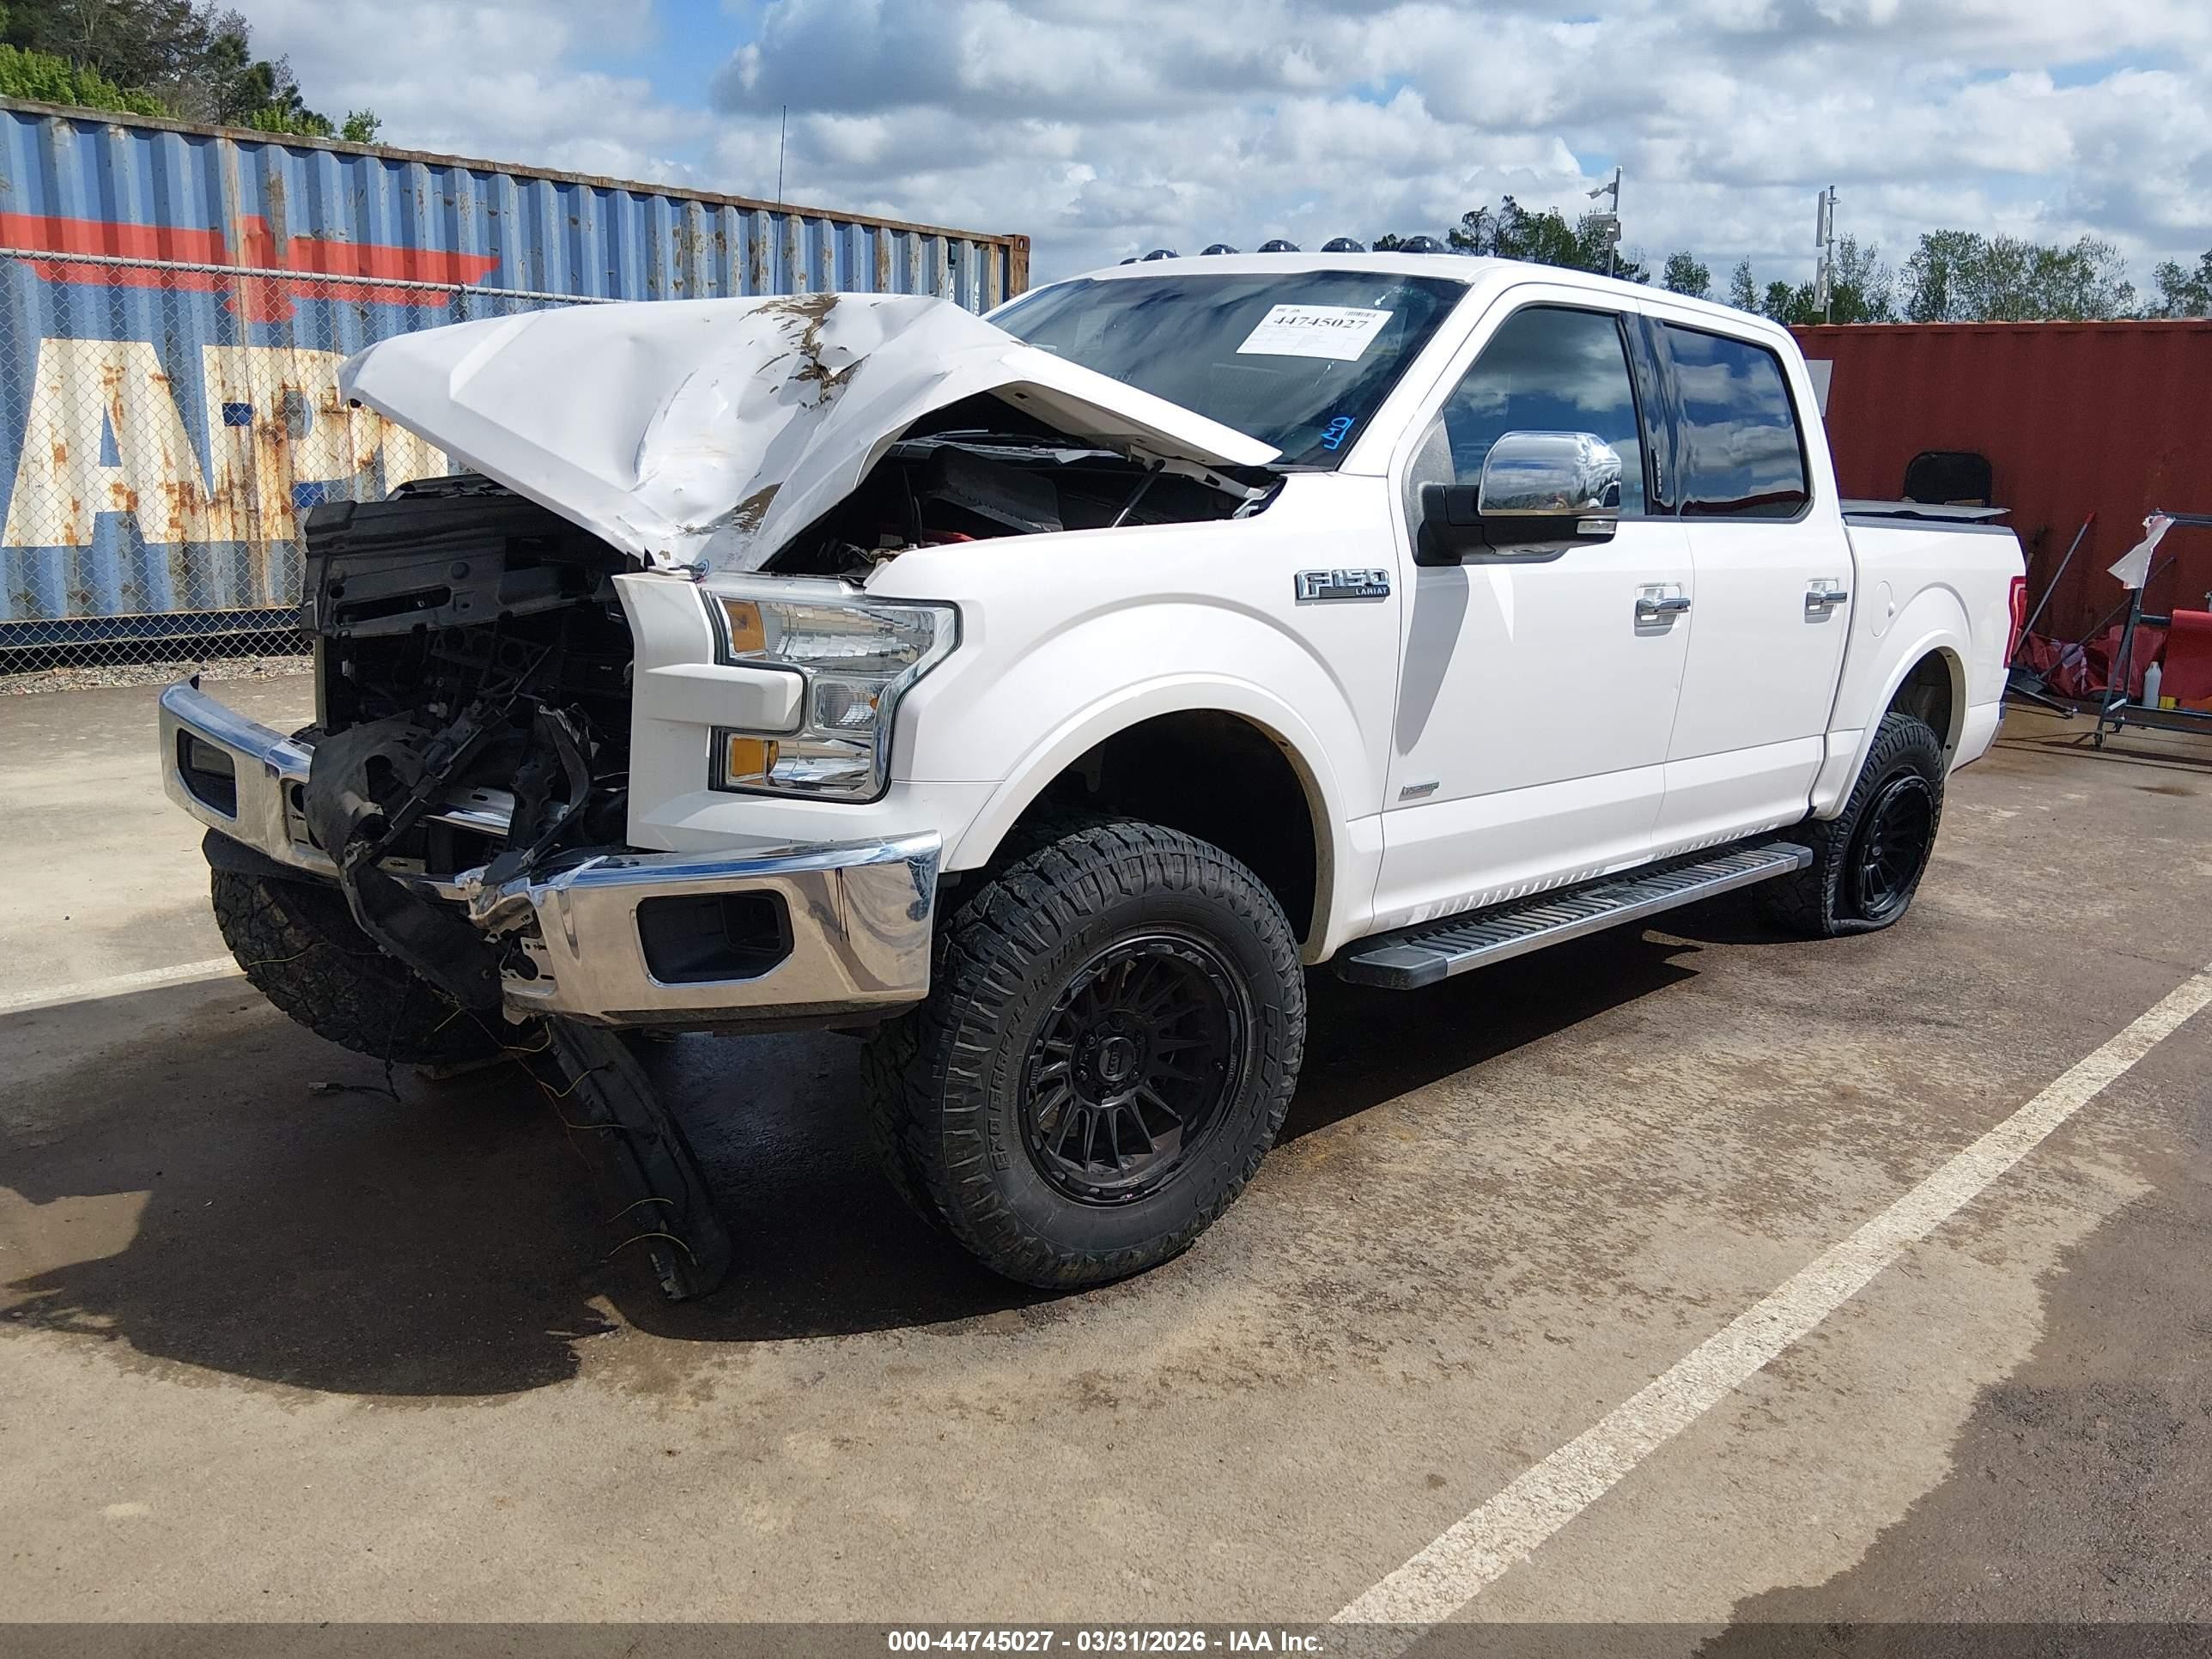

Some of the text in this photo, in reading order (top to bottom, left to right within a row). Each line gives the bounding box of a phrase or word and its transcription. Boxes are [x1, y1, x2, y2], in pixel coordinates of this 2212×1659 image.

[1273, 315, 1370, 330] 44745027
[2, 337, 450, 547] AP
[1355, 586, 1389, 596] LARIAT
